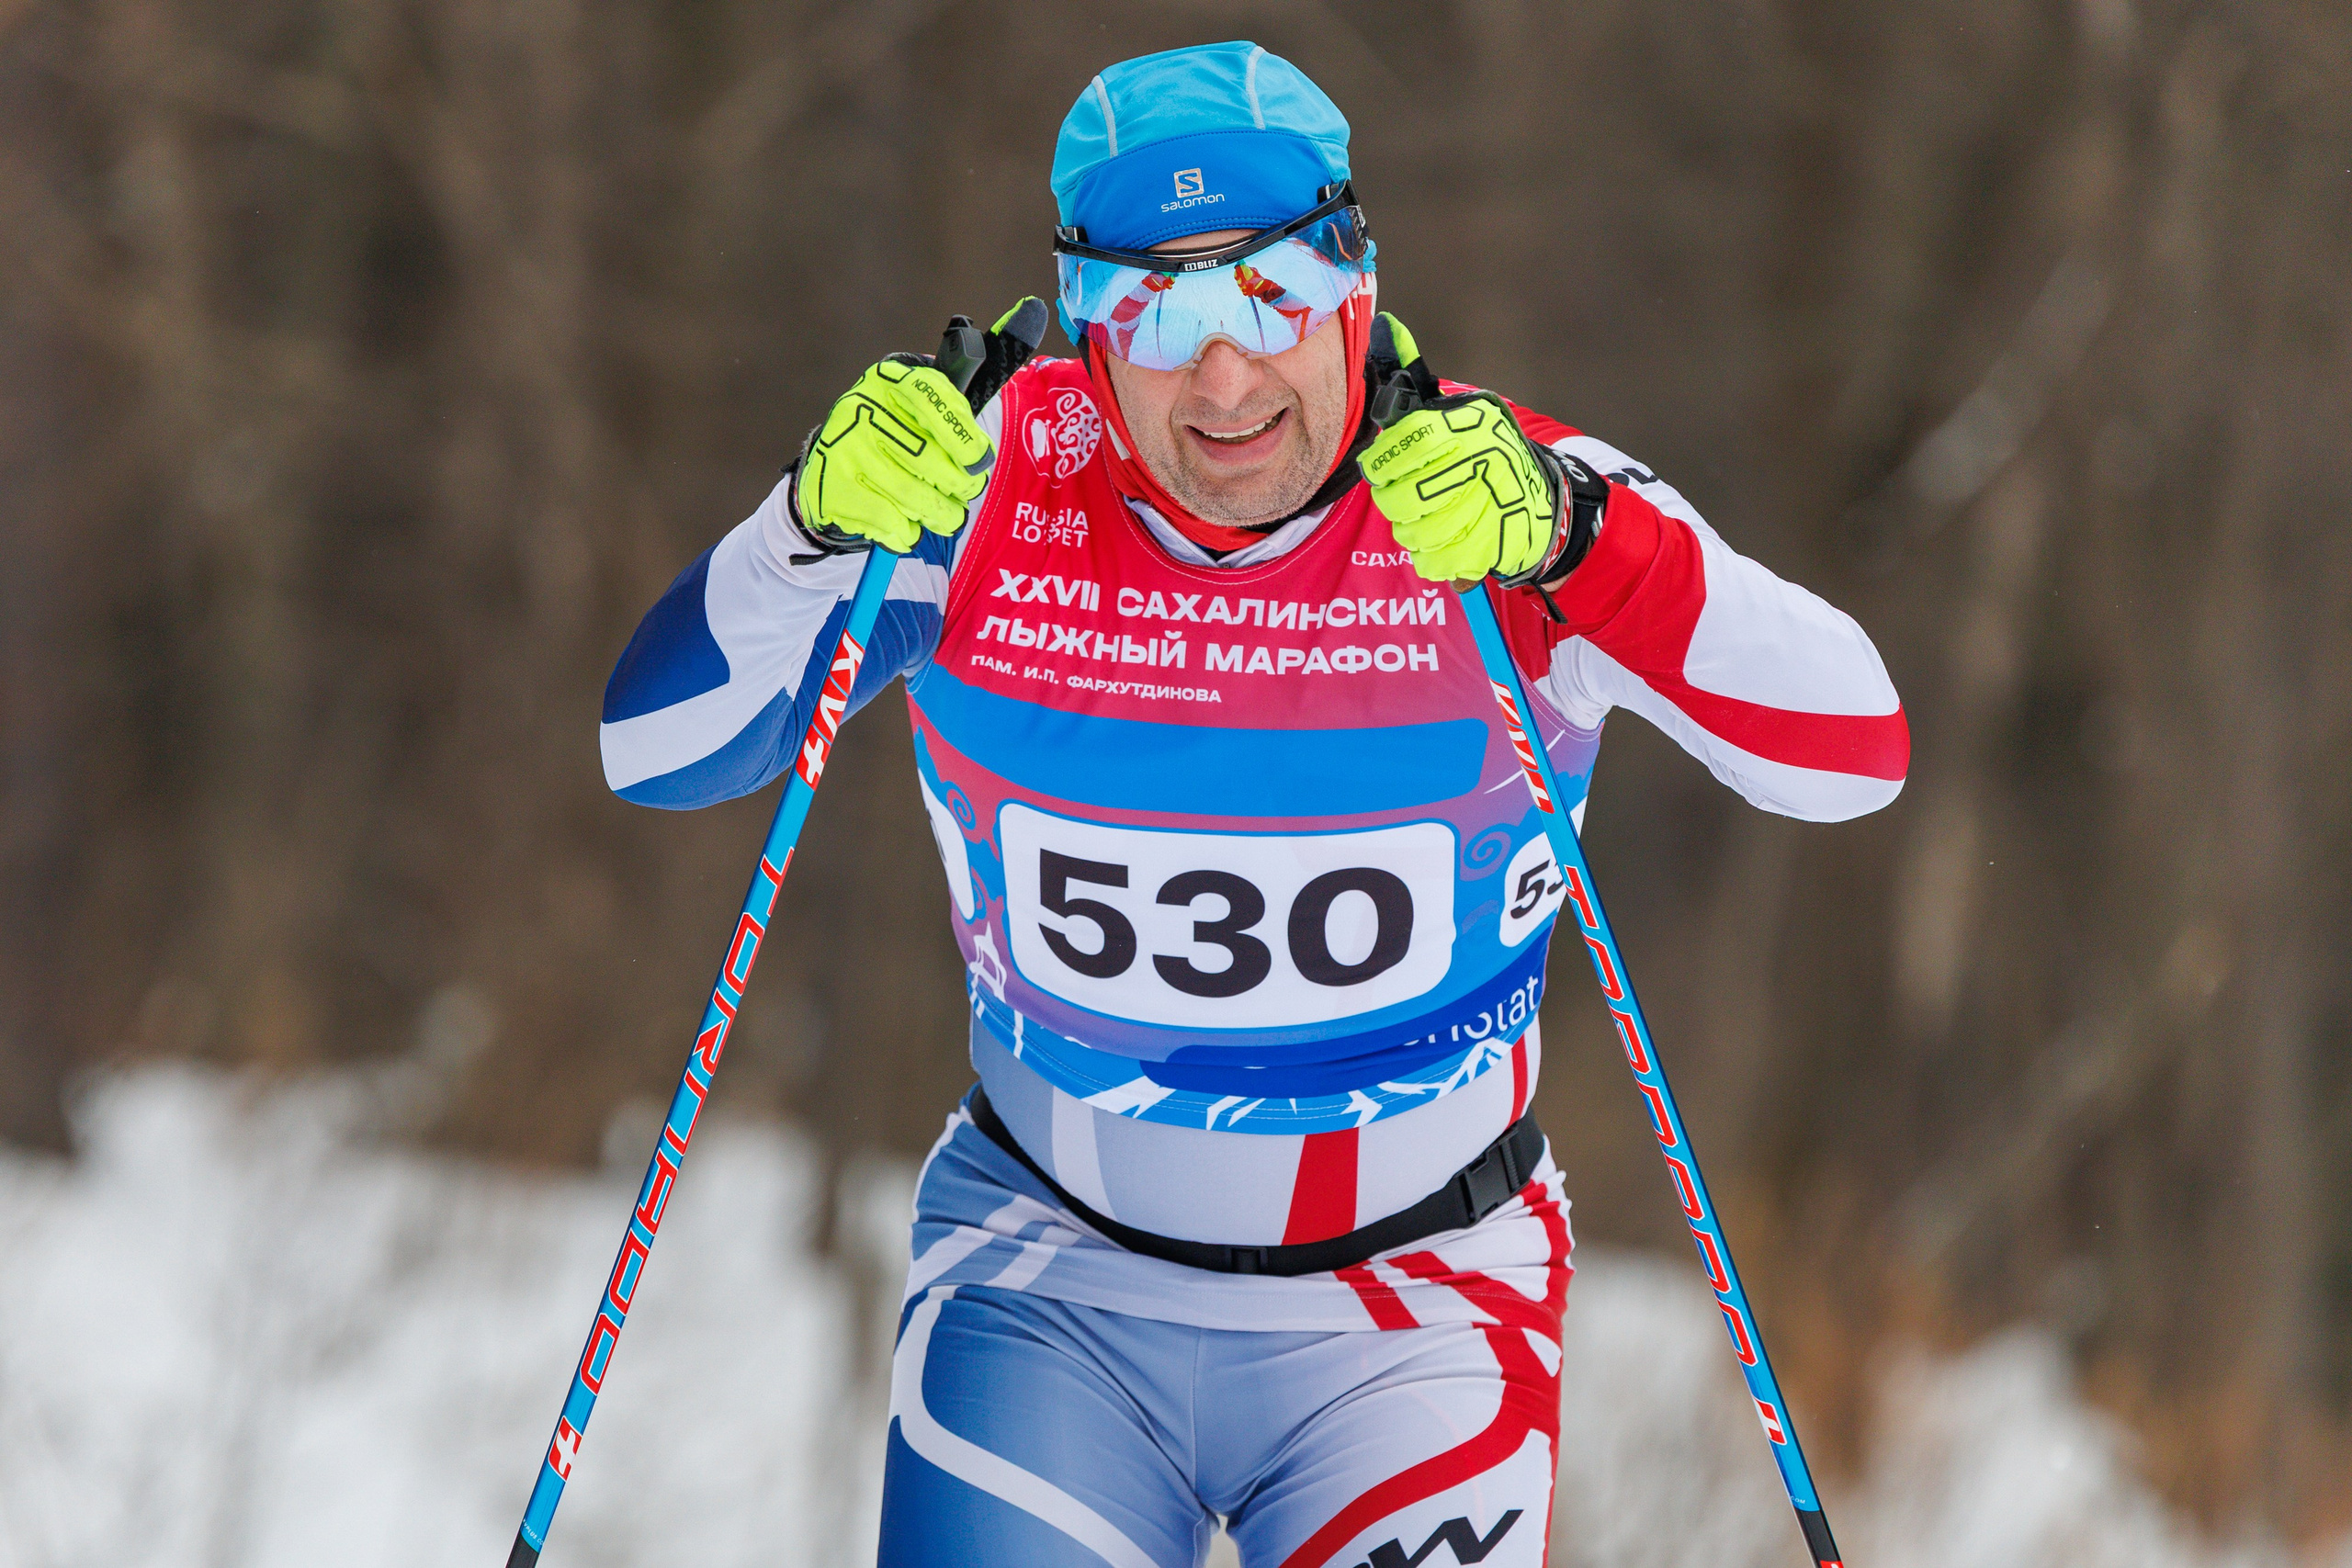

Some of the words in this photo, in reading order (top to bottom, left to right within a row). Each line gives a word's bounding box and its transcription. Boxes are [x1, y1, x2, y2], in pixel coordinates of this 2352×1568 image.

[1160, 194, 1226, 212] salomon
[1197, 259, 1218, 269] BLIZ
[911, 378, 947, 413] NORDIC
[943, 411, 974, 445] SPORT
[1370, 445, 1400, 473] NORDIC
[1399, 423, 1434, 450] SPORT
[990, 568, 1101, 612] XXVII
[1117, 587, 1446, 631] САХАЛИНСКИЙ
[977, 615, 1187, 669] ЛЫЖНЫЙ
[1204, 643, 1440, 675] МАРАФОН
[971, 655, 1017, 676] ПАМ.
[1023, 666, 1059, 685] И.П.
[1067, 675, 1222, 703] ФАРХУТДИНОВА
[1038, 848, 1414, 998] 530
[580, 846, 795, 1395] TORNADO
